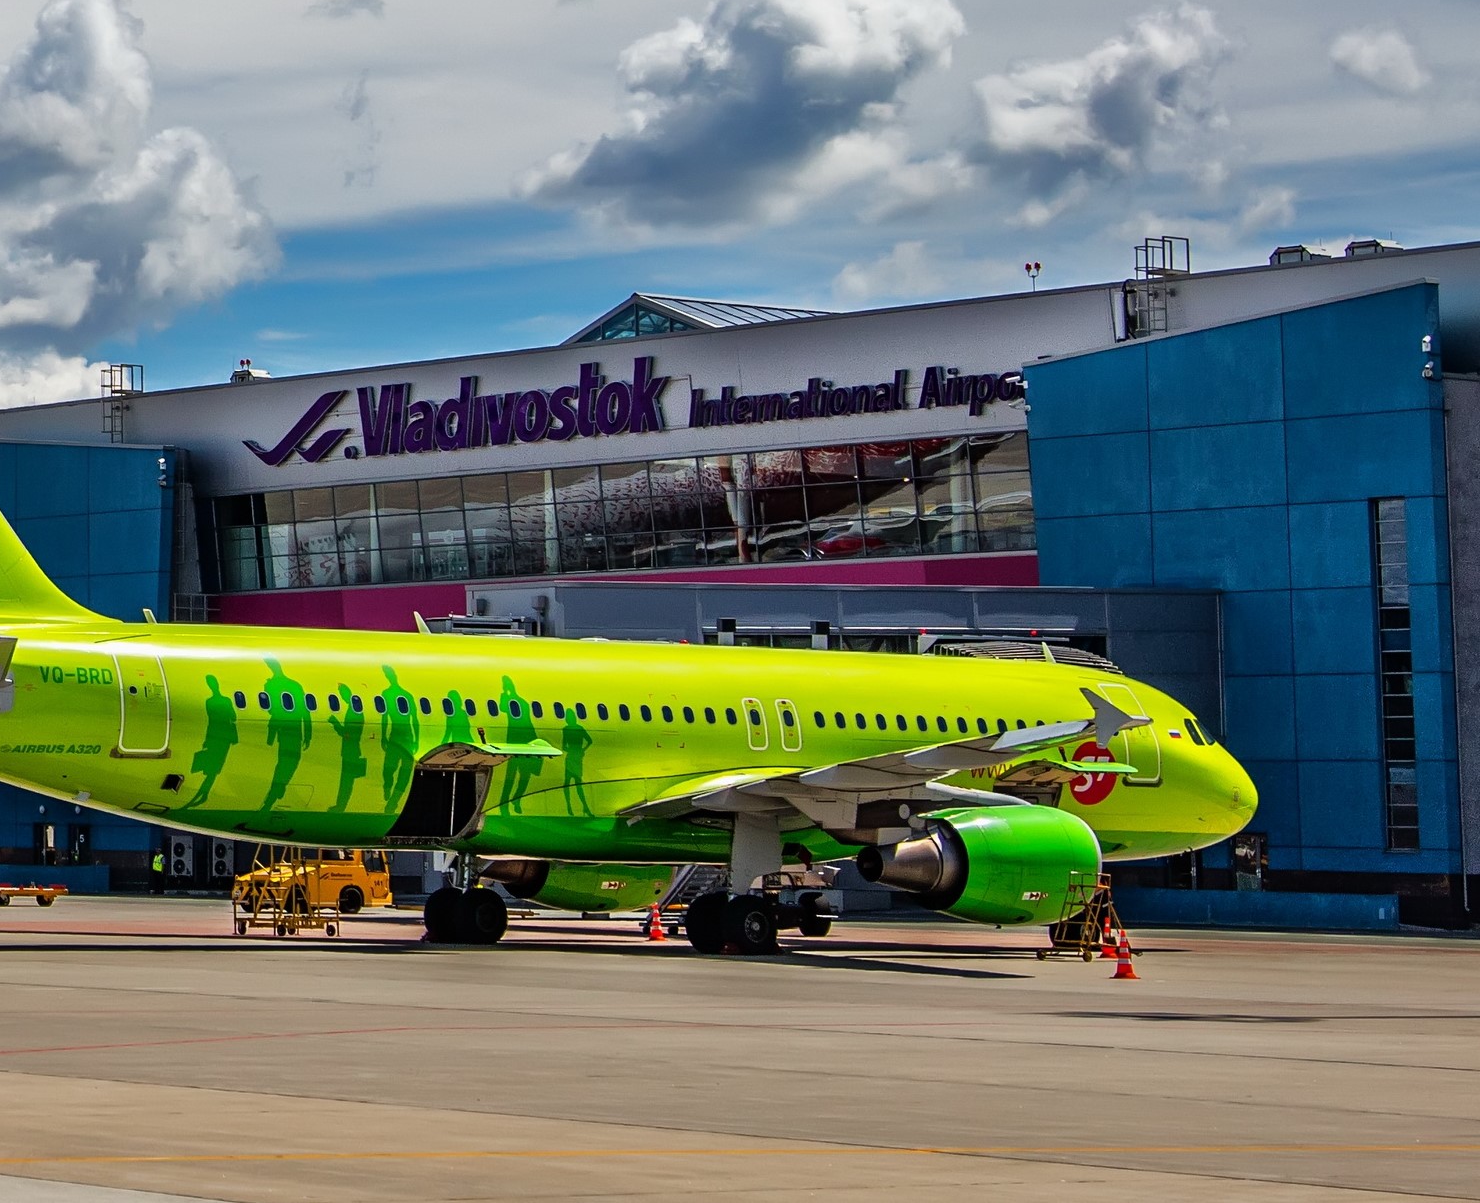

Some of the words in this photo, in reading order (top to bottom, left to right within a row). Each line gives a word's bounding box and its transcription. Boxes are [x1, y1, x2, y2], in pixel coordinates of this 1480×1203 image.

[356, 356, 671, 457] Vladivostok
[689, 369, 909, 429] International
[918, 365, 1026, 417] Airpo
[40, 665, 113, 685] VQ-BRD
[11, 744, 63, 754] AIRBUS
[67, 744, 102, 755] A320
[1074, 756, 1110, 793] S7
[79, 834, 85, 843] 5
